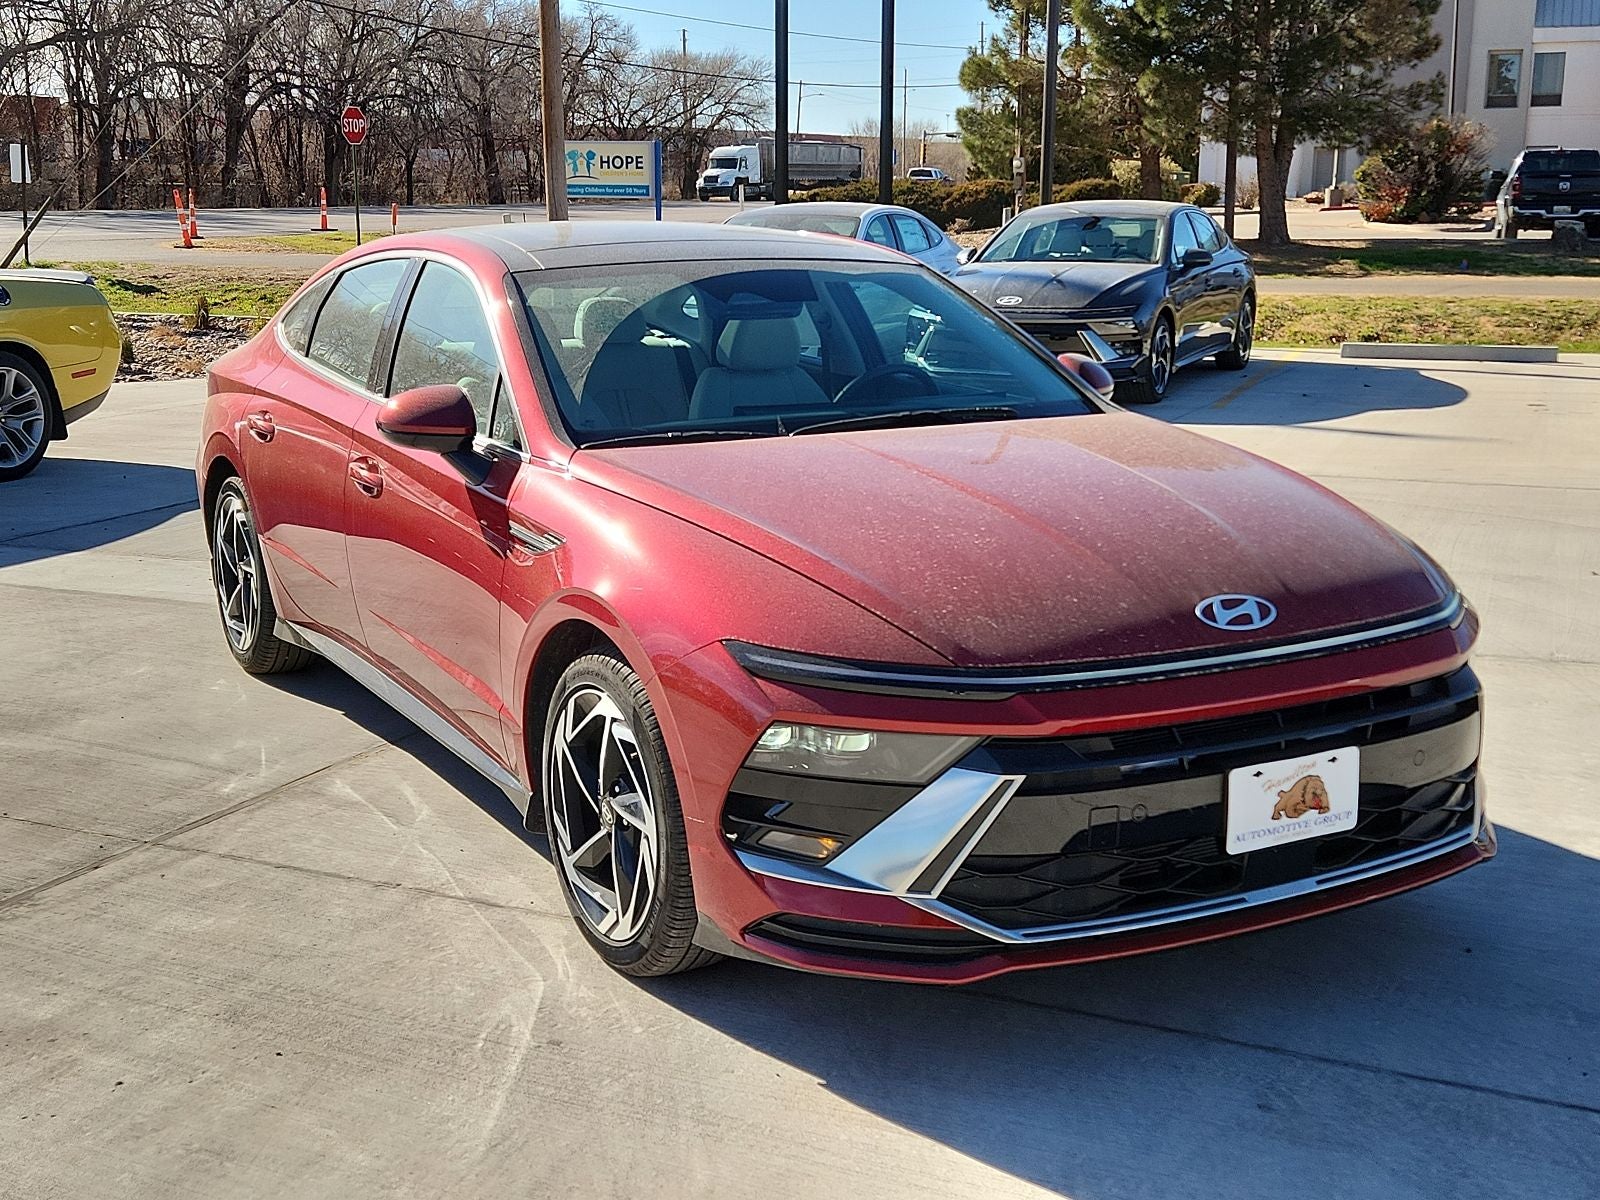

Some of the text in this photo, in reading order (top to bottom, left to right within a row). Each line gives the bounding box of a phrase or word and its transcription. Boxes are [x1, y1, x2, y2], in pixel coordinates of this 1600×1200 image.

[343, 118, 365, 133] STOP
[600, 155, 644, 170] HOPE
[585, 186, 605, 194] Children
[1234, 819, 1312, 843] AUTOMOTIVE
[1314, 810, 1353, 826] GROUP
